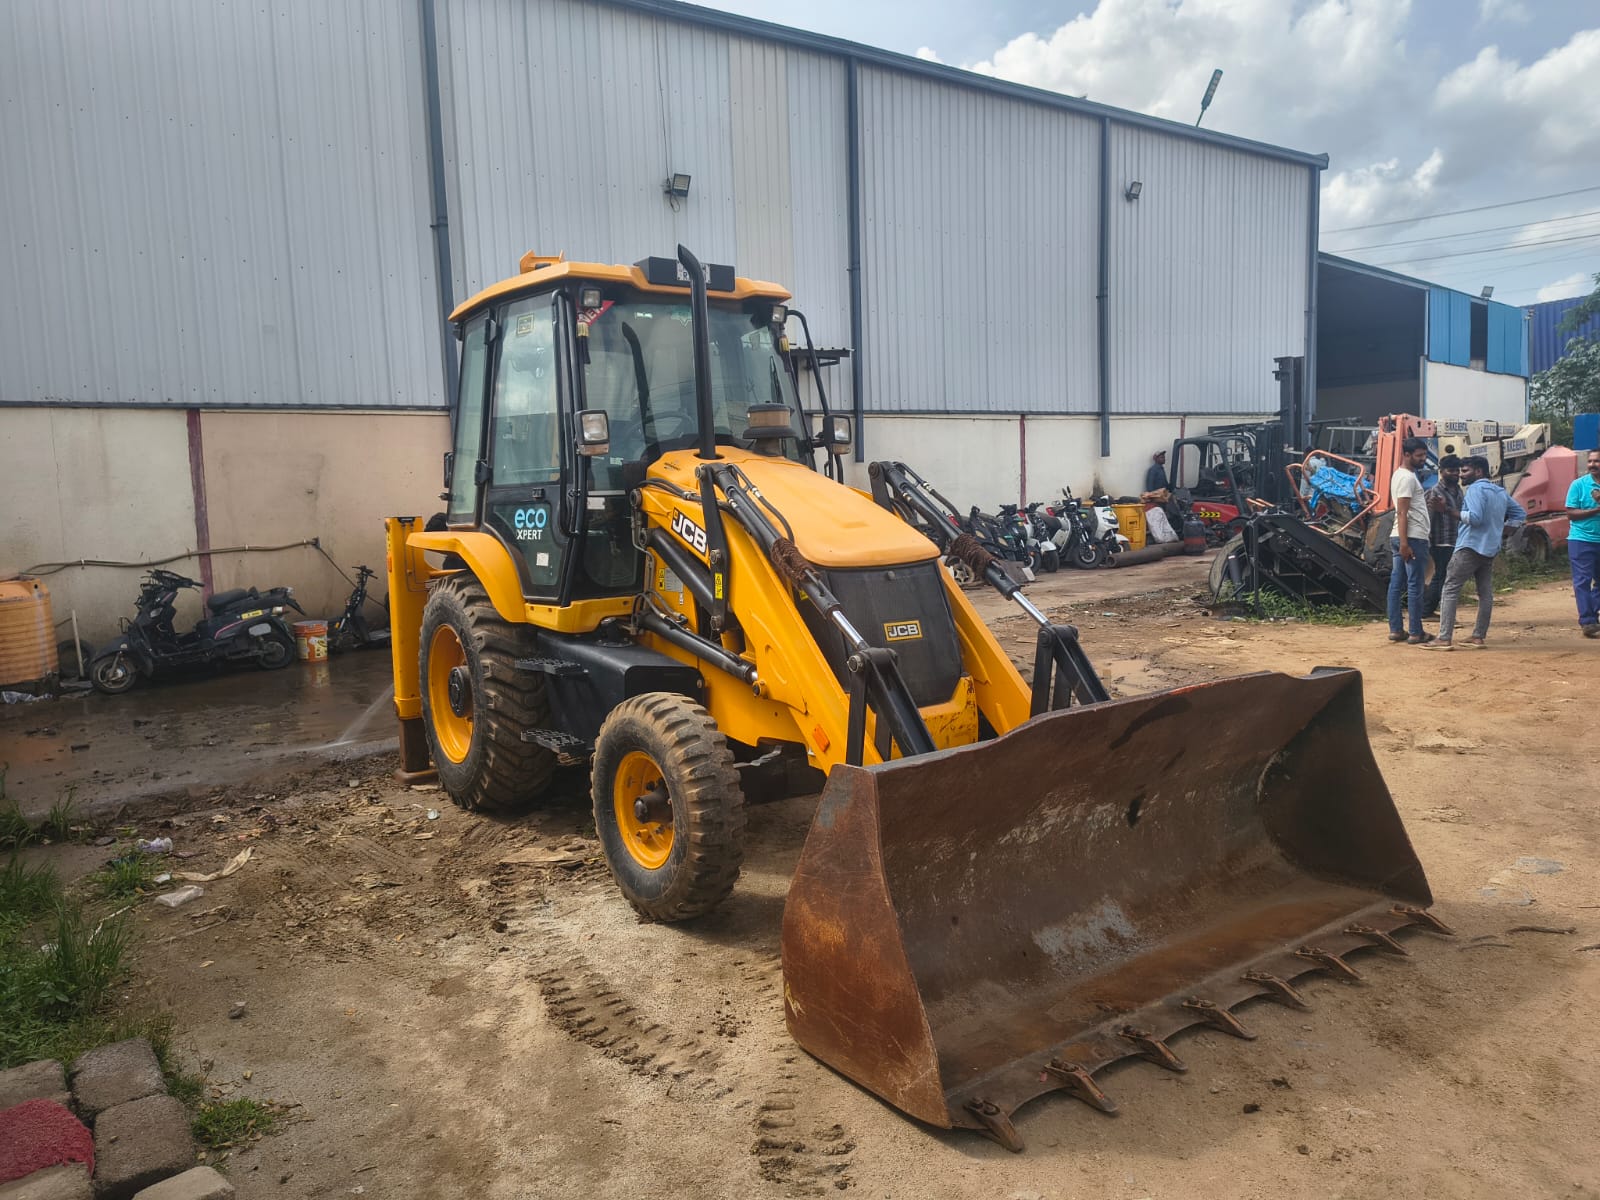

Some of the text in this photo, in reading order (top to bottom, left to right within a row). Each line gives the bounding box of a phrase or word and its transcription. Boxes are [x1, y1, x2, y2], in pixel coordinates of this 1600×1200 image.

[514, 508, 547, 528] eco
[516, 529, 543, 540] XPERT
[672, 513, 707, 553] JCB
[888, 624, 919, 637] JCB
